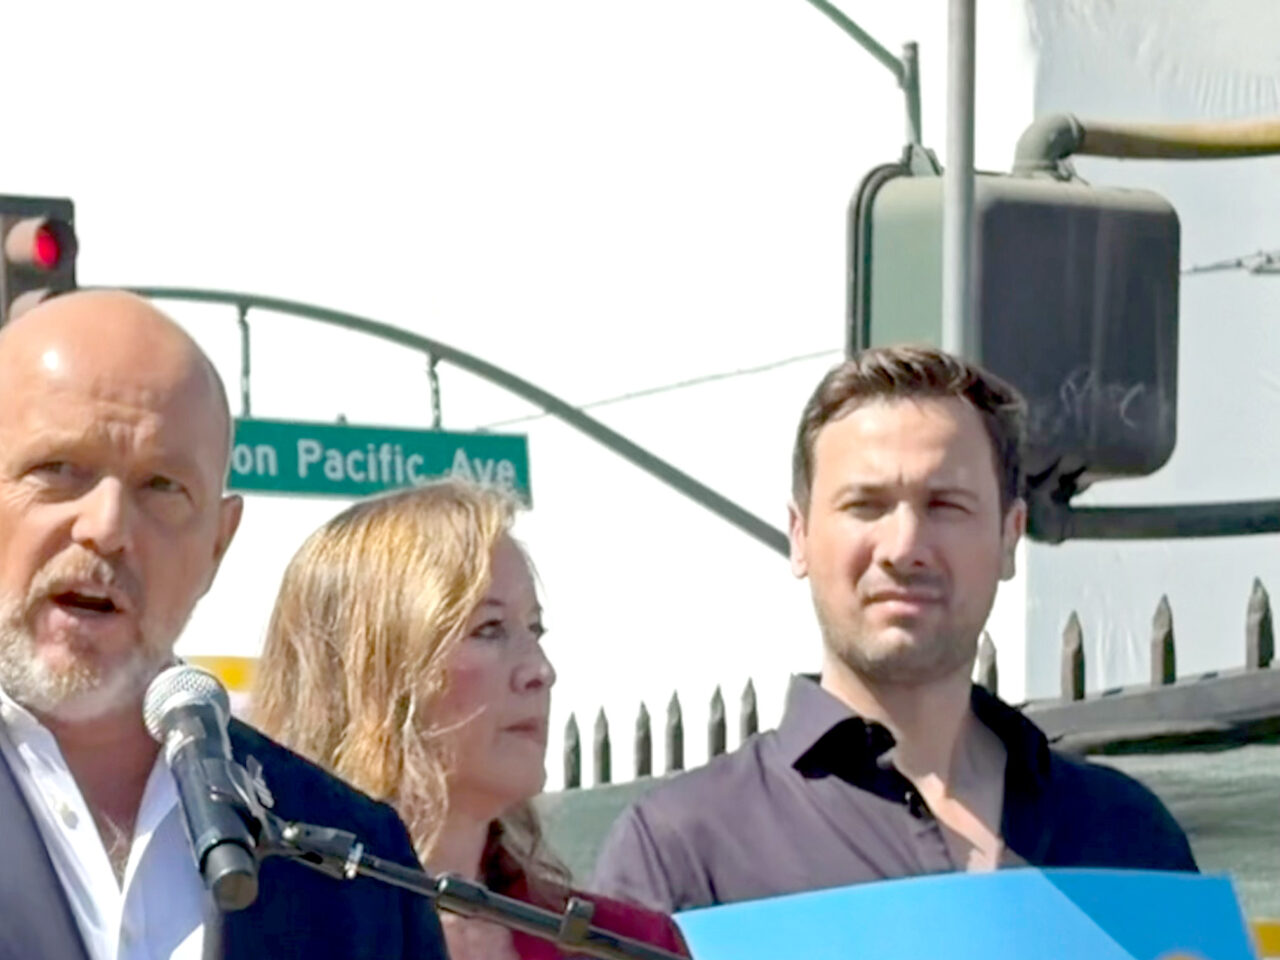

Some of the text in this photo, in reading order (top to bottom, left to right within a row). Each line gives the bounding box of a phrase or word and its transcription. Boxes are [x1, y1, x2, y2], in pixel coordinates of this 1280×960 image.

[231, 438, 517, 488] on Pacific Ave
